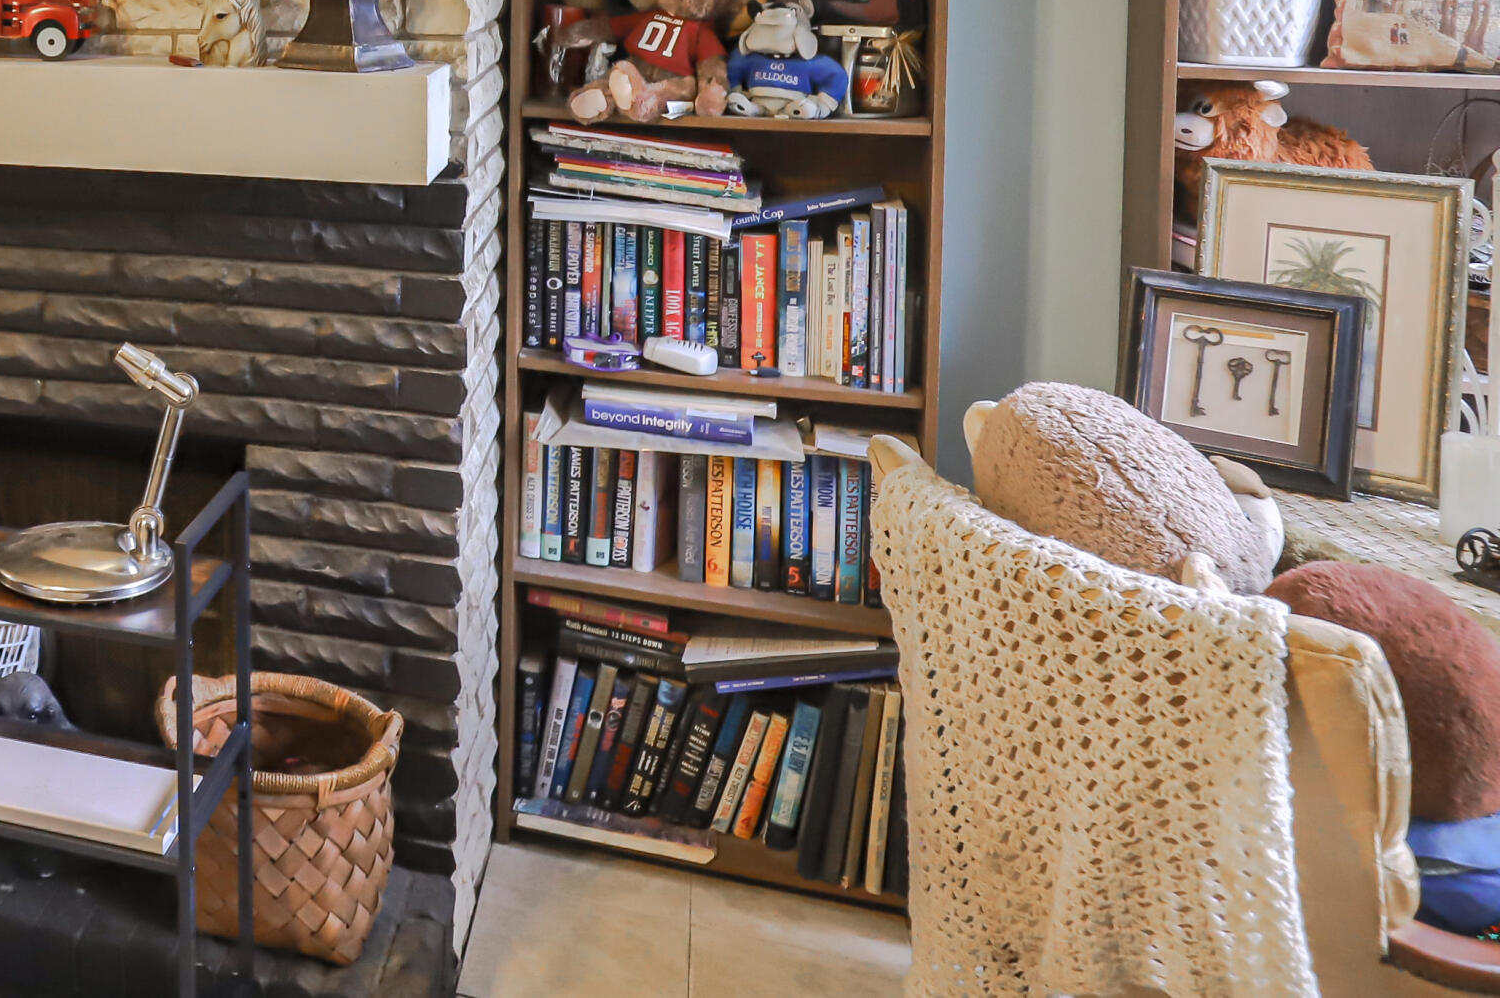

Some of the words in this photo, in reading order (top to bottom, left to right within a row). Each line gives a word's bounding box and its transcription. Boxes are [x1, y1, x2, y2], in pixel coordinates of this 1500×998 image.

[638, 21, 681, 58] 01
[755, 72, 798, 85] BULLDOGS
[770, 63, 784, 71] GO
[762, 209, 783, 220] Cop
[549, 222, 560, 272] TANKHAMUN
[585, 232, 594, 273] SURVIVOR
[625, 232, 636, 268] PATRICIA
[693, 235, 702, 259] STREET
[567, 252, 579, 284] POYER
[692, 261, 702, 287] LAWYER
[755, 263, 765, 299] JANCE
[827, 263, 836, 275] The
[666, 290, 681, 315] LOOK
[591, 409, 640, 425] beyond
[570, 447, 582, 478] JAMES
[547, 459, 560, 525] PATTERSON
[568, 479, 580, 536] PATTERSON
[615, 486, 631, 530] PATTERSON
[818, 474, 833, 508] YMOON
[710, 479, 723, 547] PATTERSON
[736, 492, 752, 530] HOUSE
[790, 490, 804, 560] PATTERSON
[844, 495, 858, 565] PATTERSON
[788, 566, 799, 583] 5
[566, 619, 581, 631] Ruth
[621, 633, 641, 644] STEPS
[643, 638, 663, 649] DOWN
